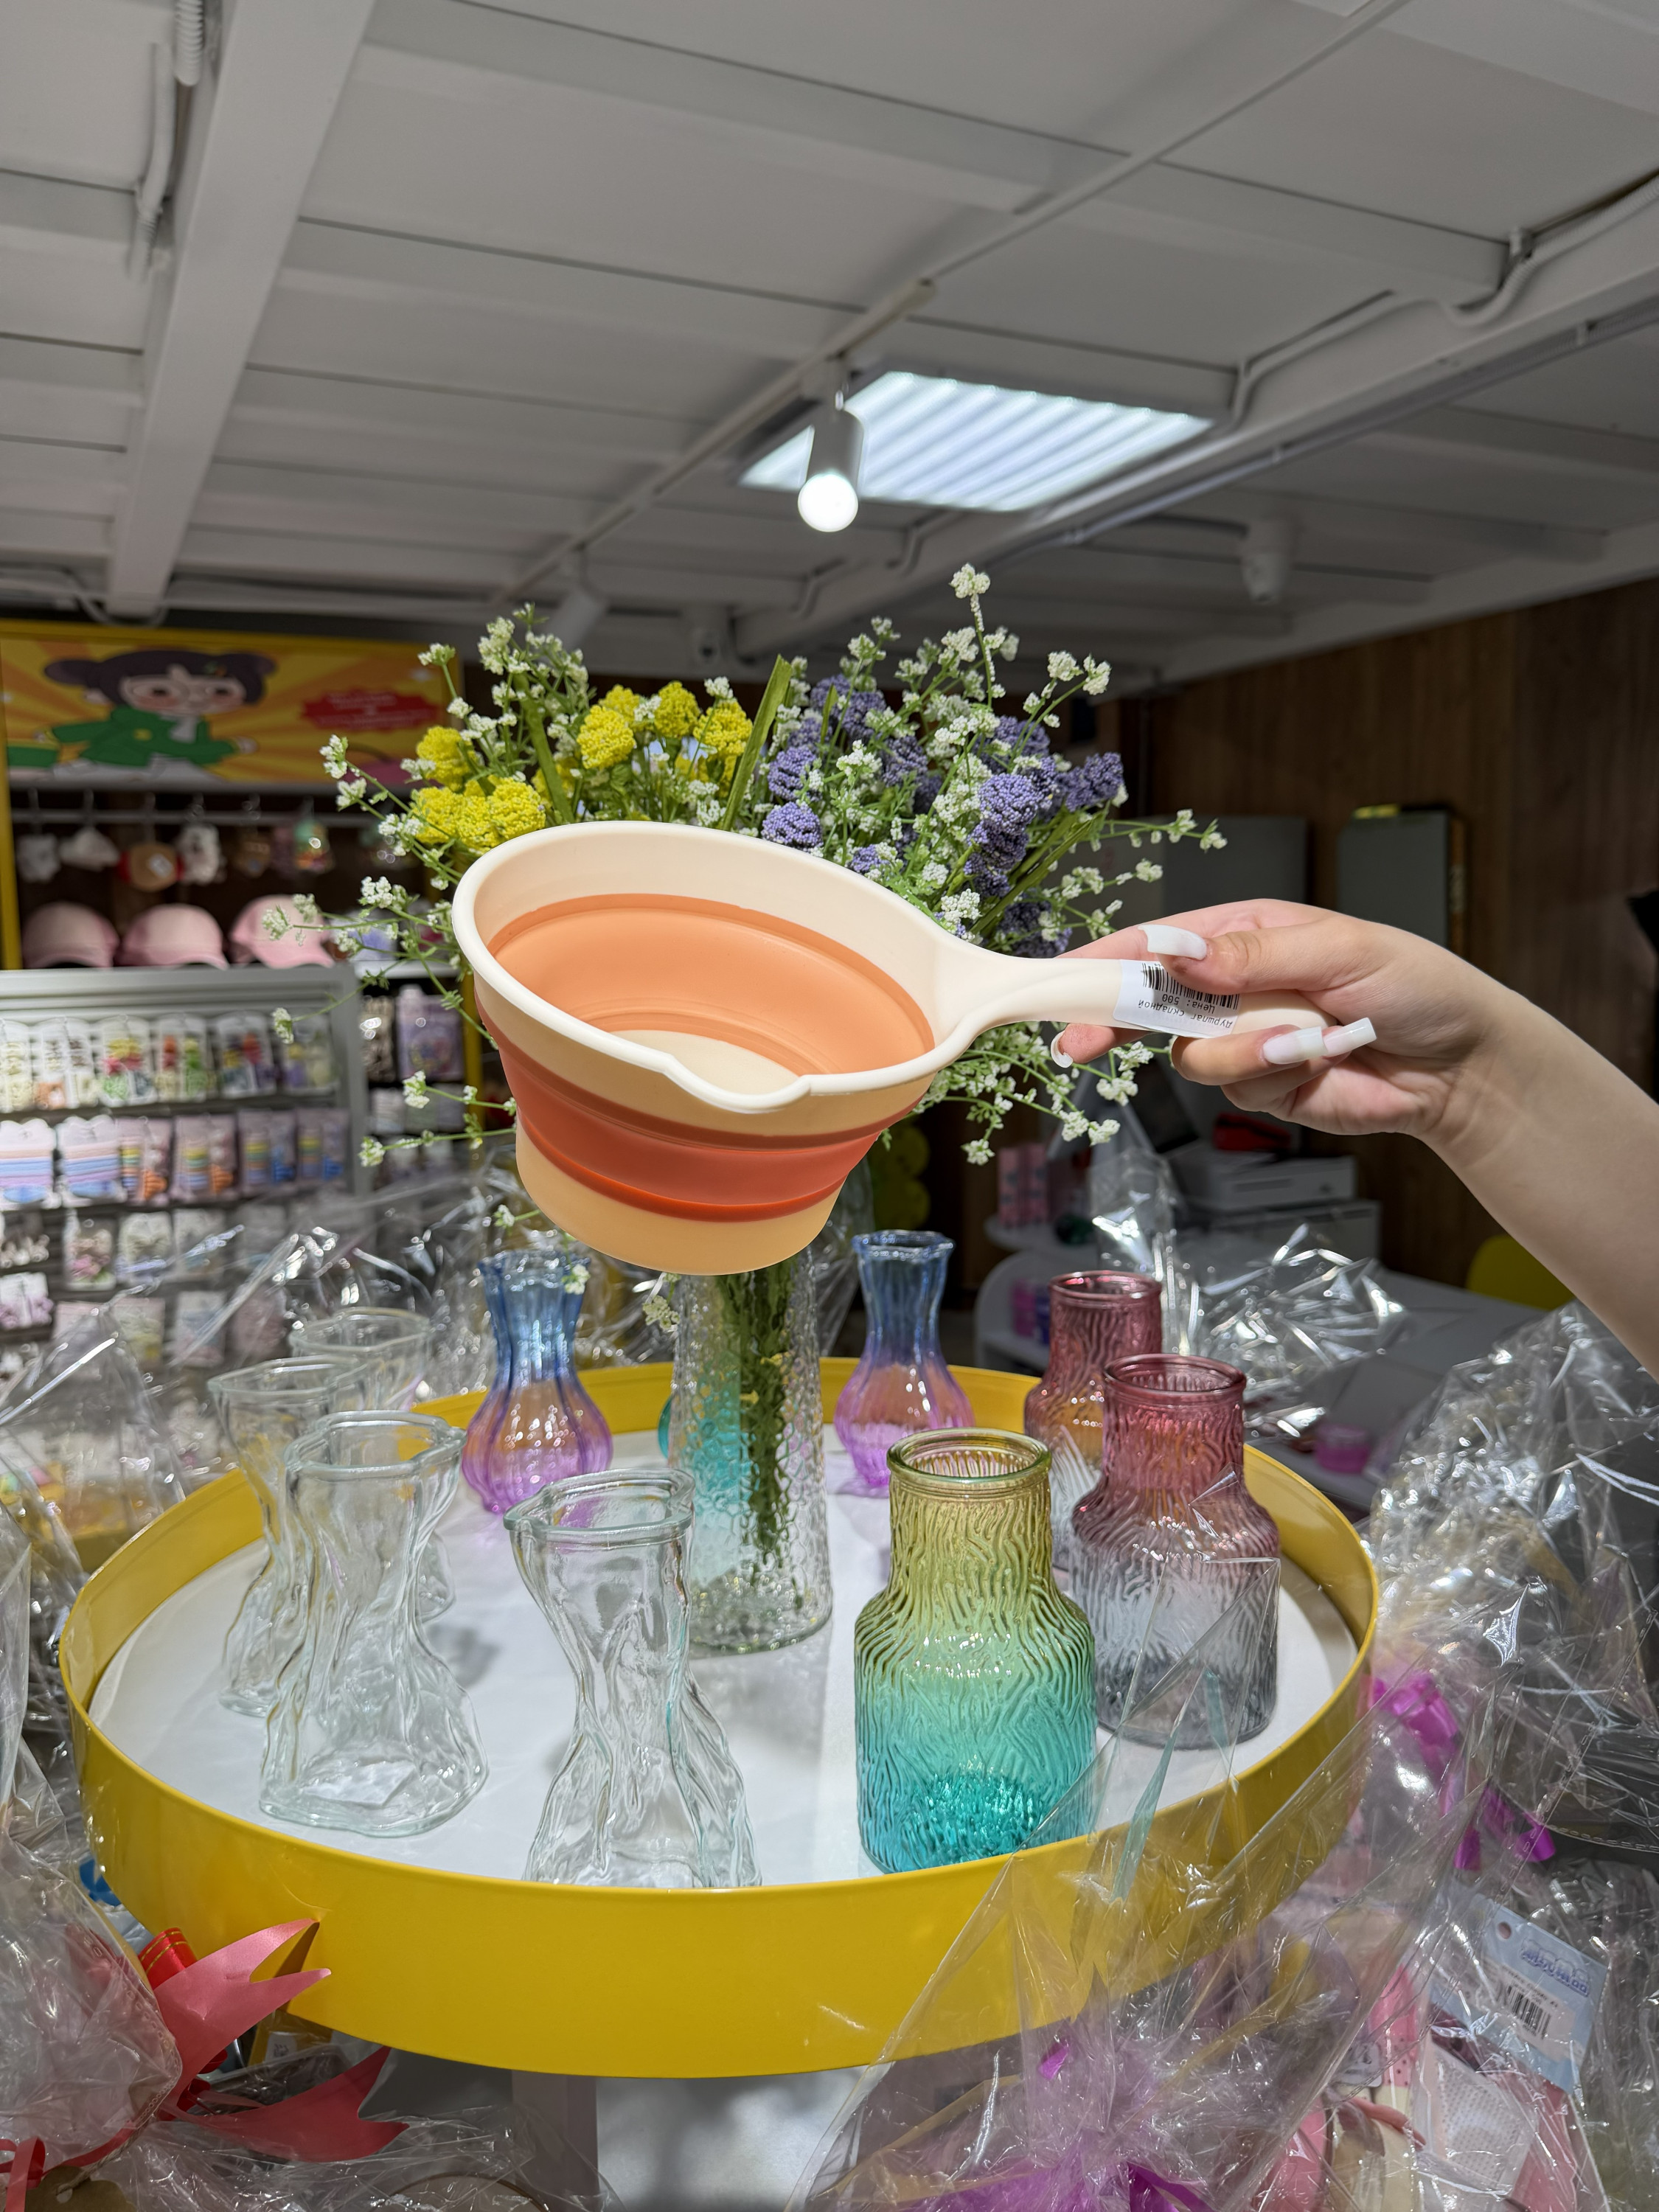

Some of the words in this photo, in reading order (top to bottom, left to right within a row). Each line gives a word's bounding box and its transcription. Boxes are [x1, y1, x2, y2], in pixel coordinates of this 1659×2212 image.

[1162, 993, 1179, 1005] 500
[1138, 999, 1185, 1017] складной
[1186, 1000, 1215, 1014] Цена:
